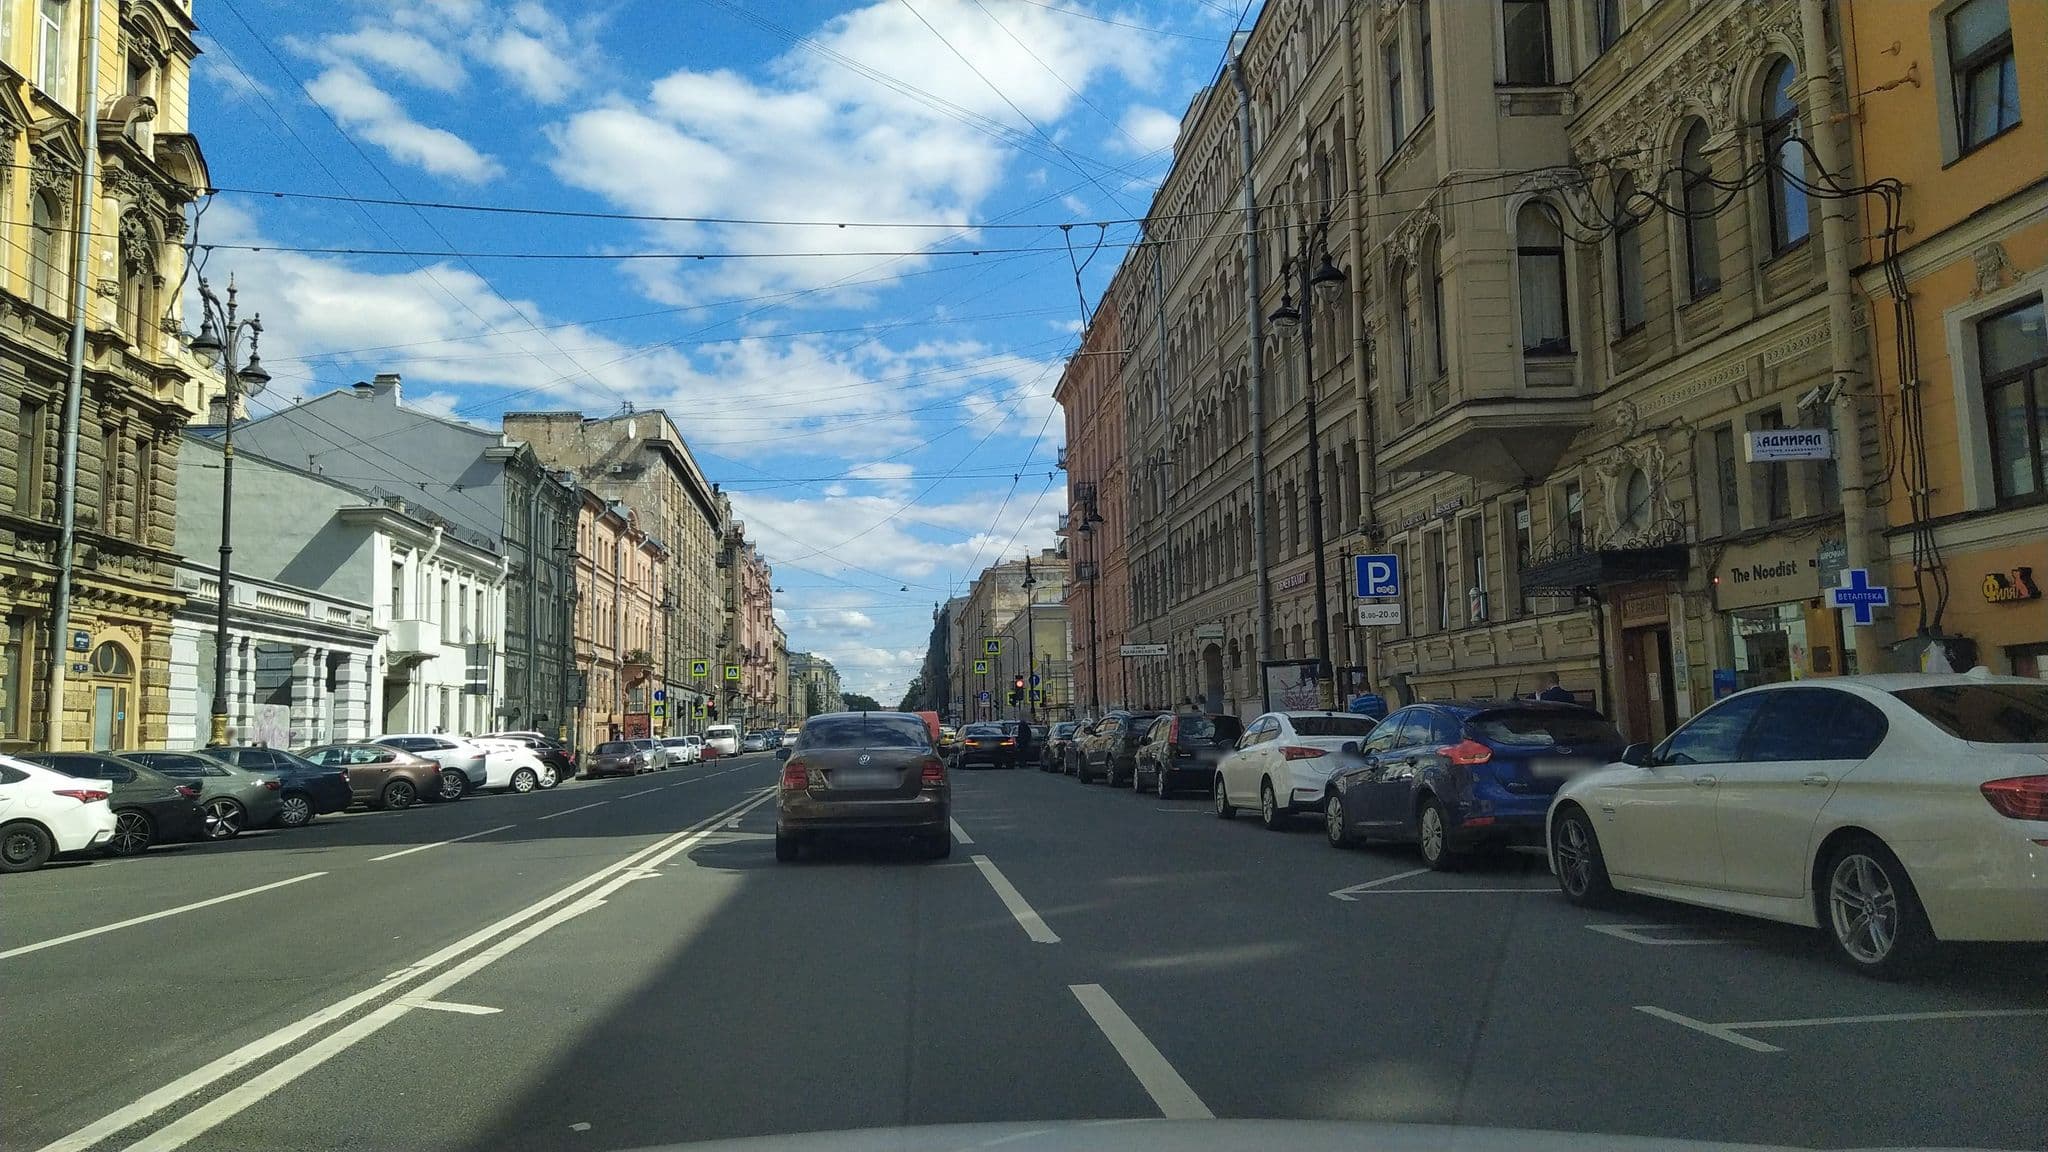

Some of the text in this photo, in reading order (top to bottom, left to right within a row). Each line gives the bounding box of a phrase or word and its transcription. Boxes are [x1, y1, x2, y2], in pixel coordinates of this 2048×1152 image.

[1762, 434, 1821, 447] АДМИРАЛ
[1368, 562, 1391, 595] P
[1731, 560, 1798, 583] The Noodist
[1838, 592, 1884, 602] ВЕТАПТЕКА
